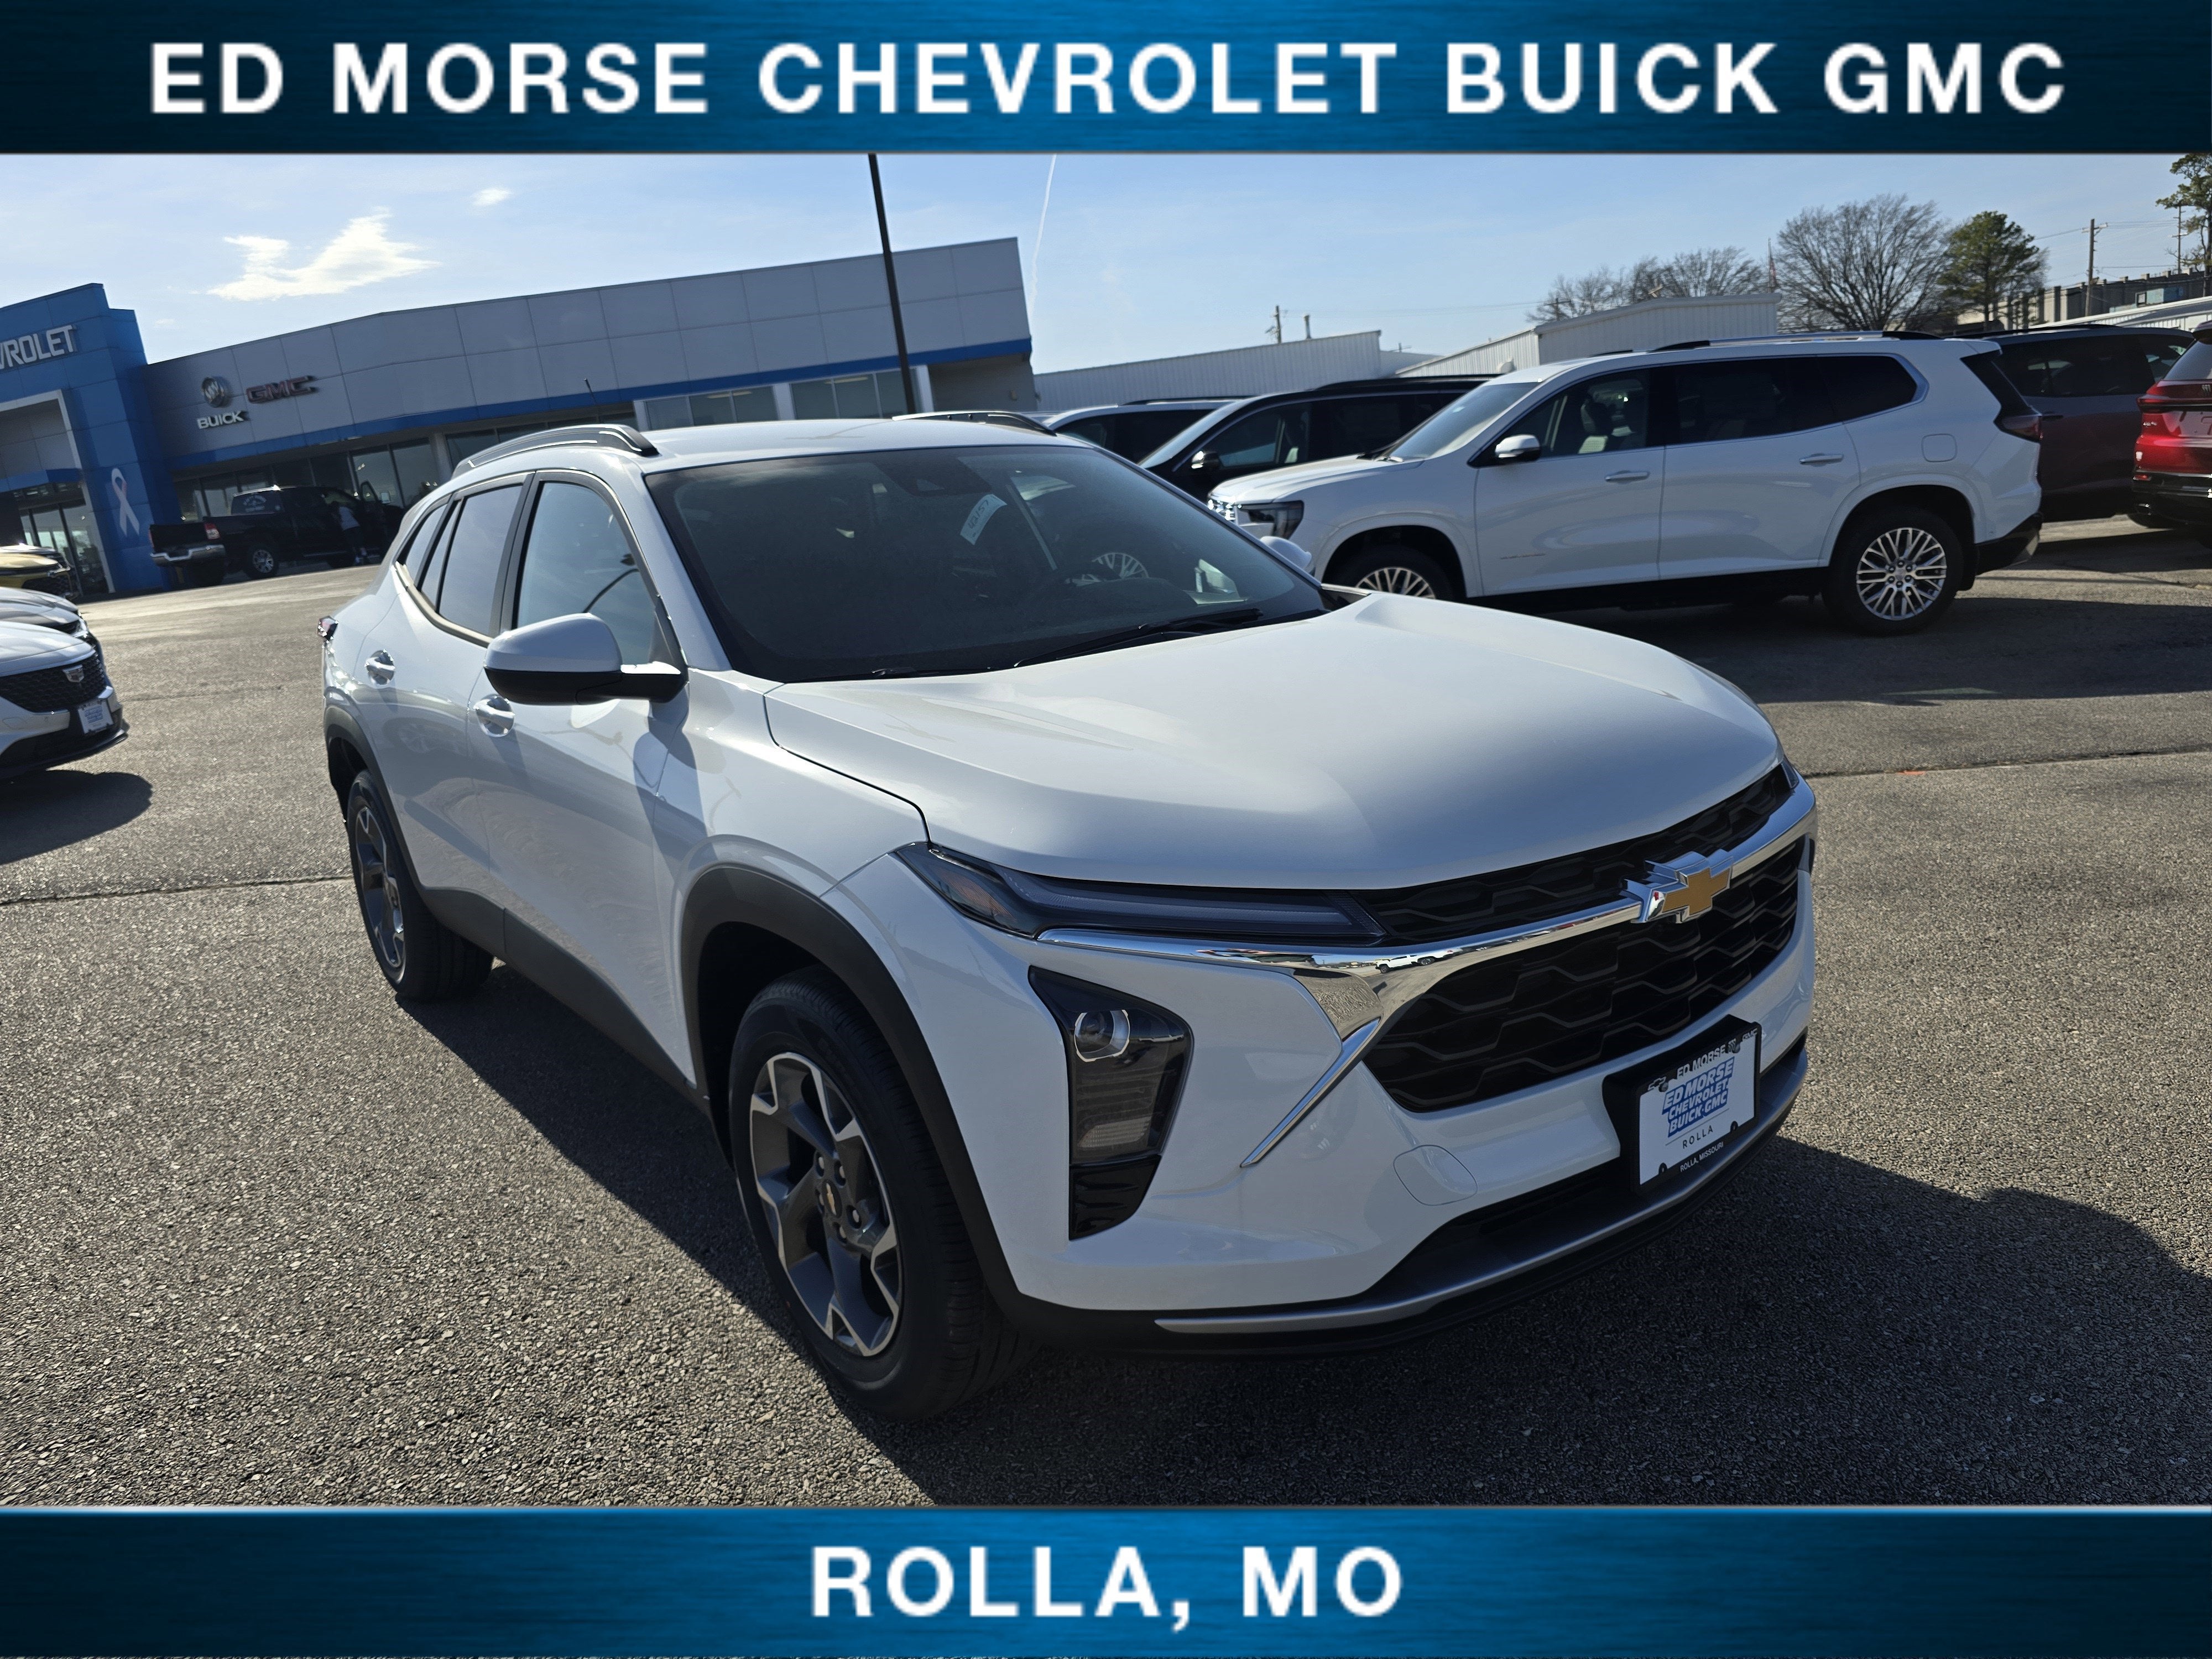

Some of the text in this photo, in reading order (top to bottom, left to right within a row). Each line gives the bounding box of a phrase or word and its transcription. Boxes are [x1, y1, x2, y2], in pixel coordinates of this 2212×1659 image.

[246, 377, 311, 403] GMC
[197, 410, 244, 429] BUICK
[1677, 1064, 1689, 1079] ED
[1692, 1044, 1725, 1072] MORSE
[1663, 1058, 1734, 1110] ED MORSE
[1669, 1079, 1728, 1120] CHEVROLET
[1683, 1125, 1713, 1149] ROLLA
[1680, 1141, 1724, 1172] ROLLA, MISSOURI
